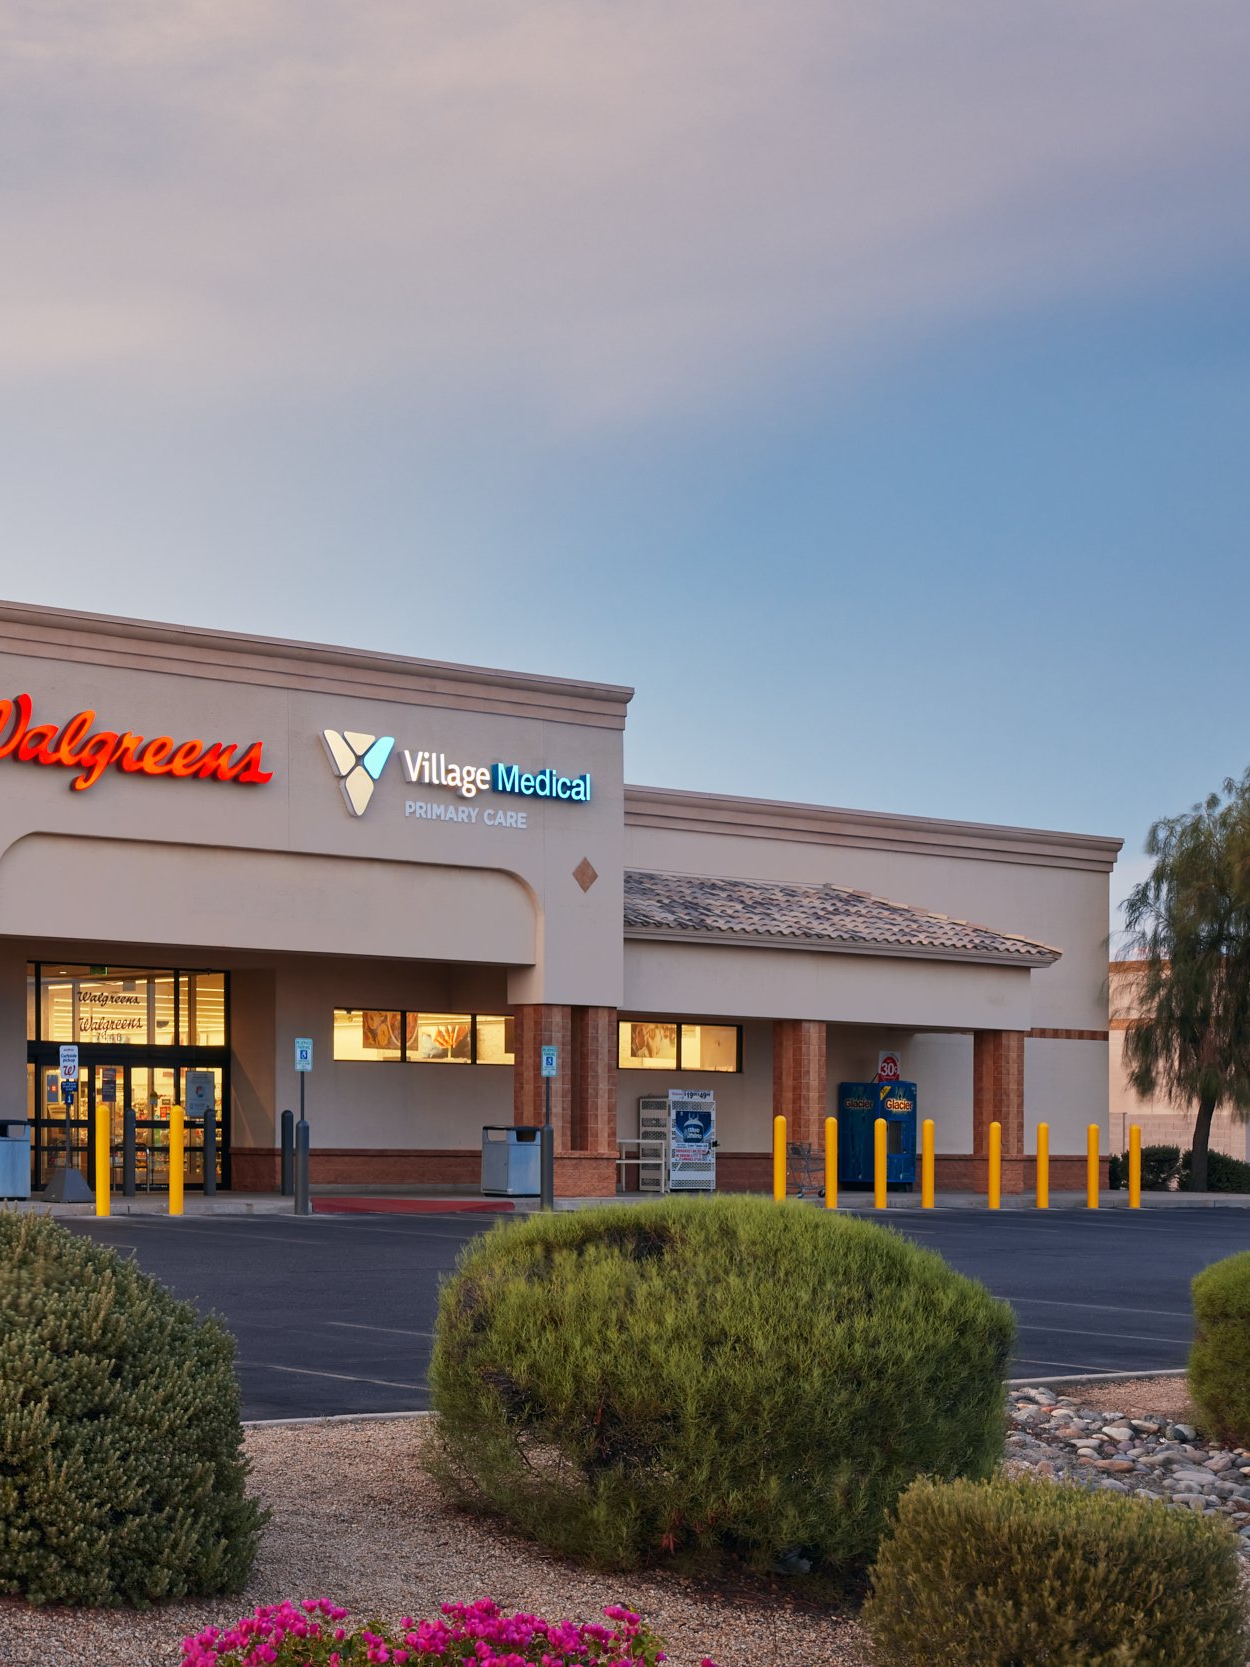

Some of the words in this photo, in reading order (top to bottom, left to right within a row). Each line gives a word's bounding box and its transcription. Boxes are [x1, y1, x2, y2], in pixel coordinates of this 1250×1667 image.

[402, 749, 491, 798] Village
[494, 762, 591, 801] Medical
[405, 800, 479, 824] PRIMARY
[483, 808, 527, 829] CARE
[77, 991, 141, 1007] Walgreens
[78, 1016, 143, 1032] Walgreens
[845, 1100, 873, 1109] Glacier
[885, 1099, 913, 1110] Glacier
